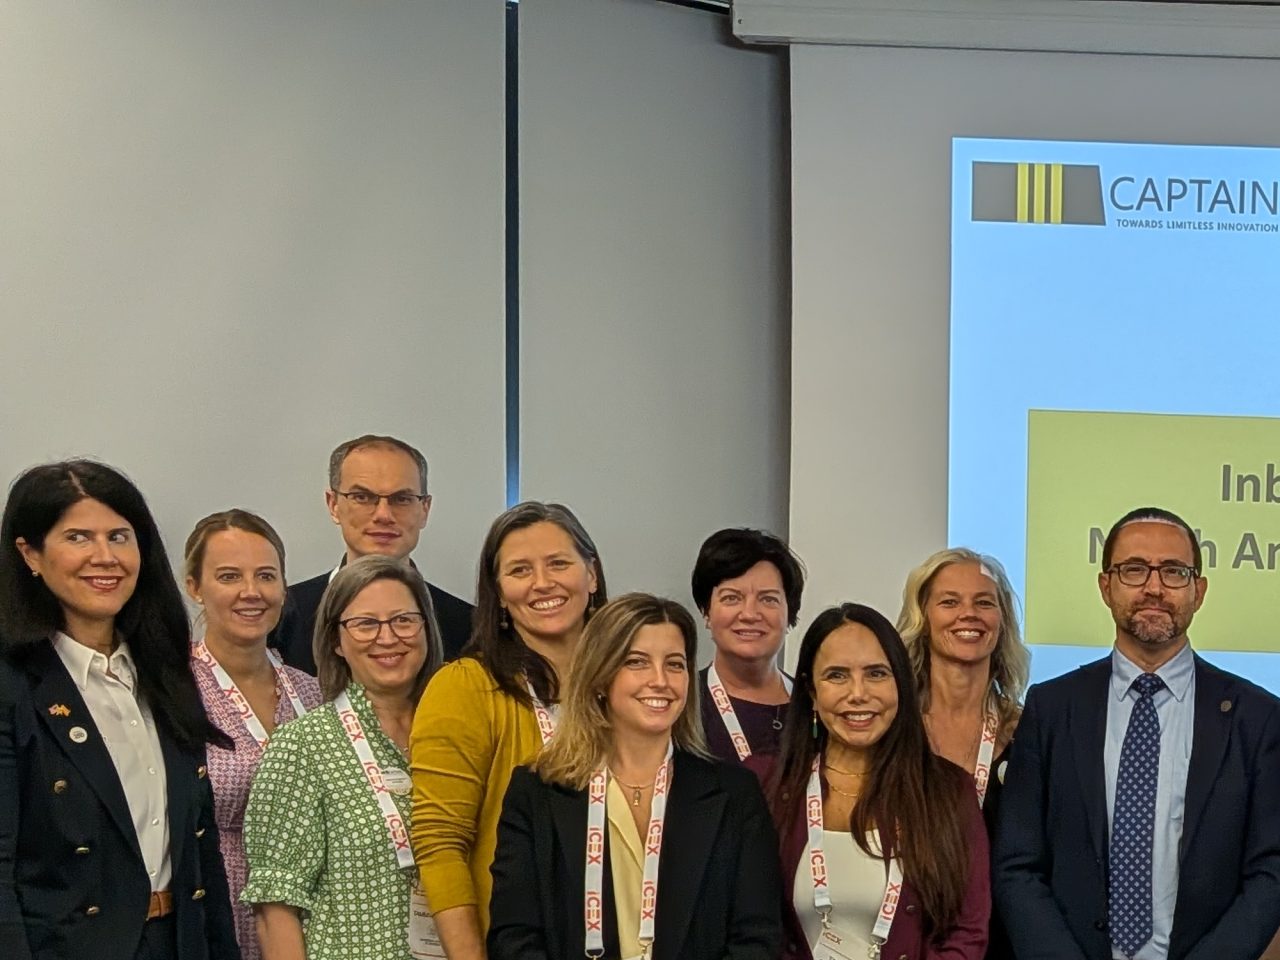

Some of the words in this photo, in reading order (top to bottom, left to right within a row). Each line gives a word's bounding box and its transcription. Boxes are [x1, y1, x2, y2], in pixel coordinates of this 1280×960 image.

[1110, 176, 1278, 216] CAPTAIN
[1116, 219, 1164, 229] TOWARDS
[1167, 220, 1214, 231] LIMITLESS
[1217, 222, 1279, 233] INNOVATION
[711, 684, 733, 716] ICEX
[340, 709, 365, 743] ICEX
[364, 761, 388, 794] ICEX
[808, 795, 822, 828] ICEX
[386, 813, 410, 850] ICEX
[587, 827, 602, 865] ICEX
[646, 819, 662, 857] ICEX
[811, 849, 828, 889] ICEX
[586, 891, 601, 932] ICEX
[642, 880, 656, 920] ICEX
[881, 881, 901, 922] ICEX
